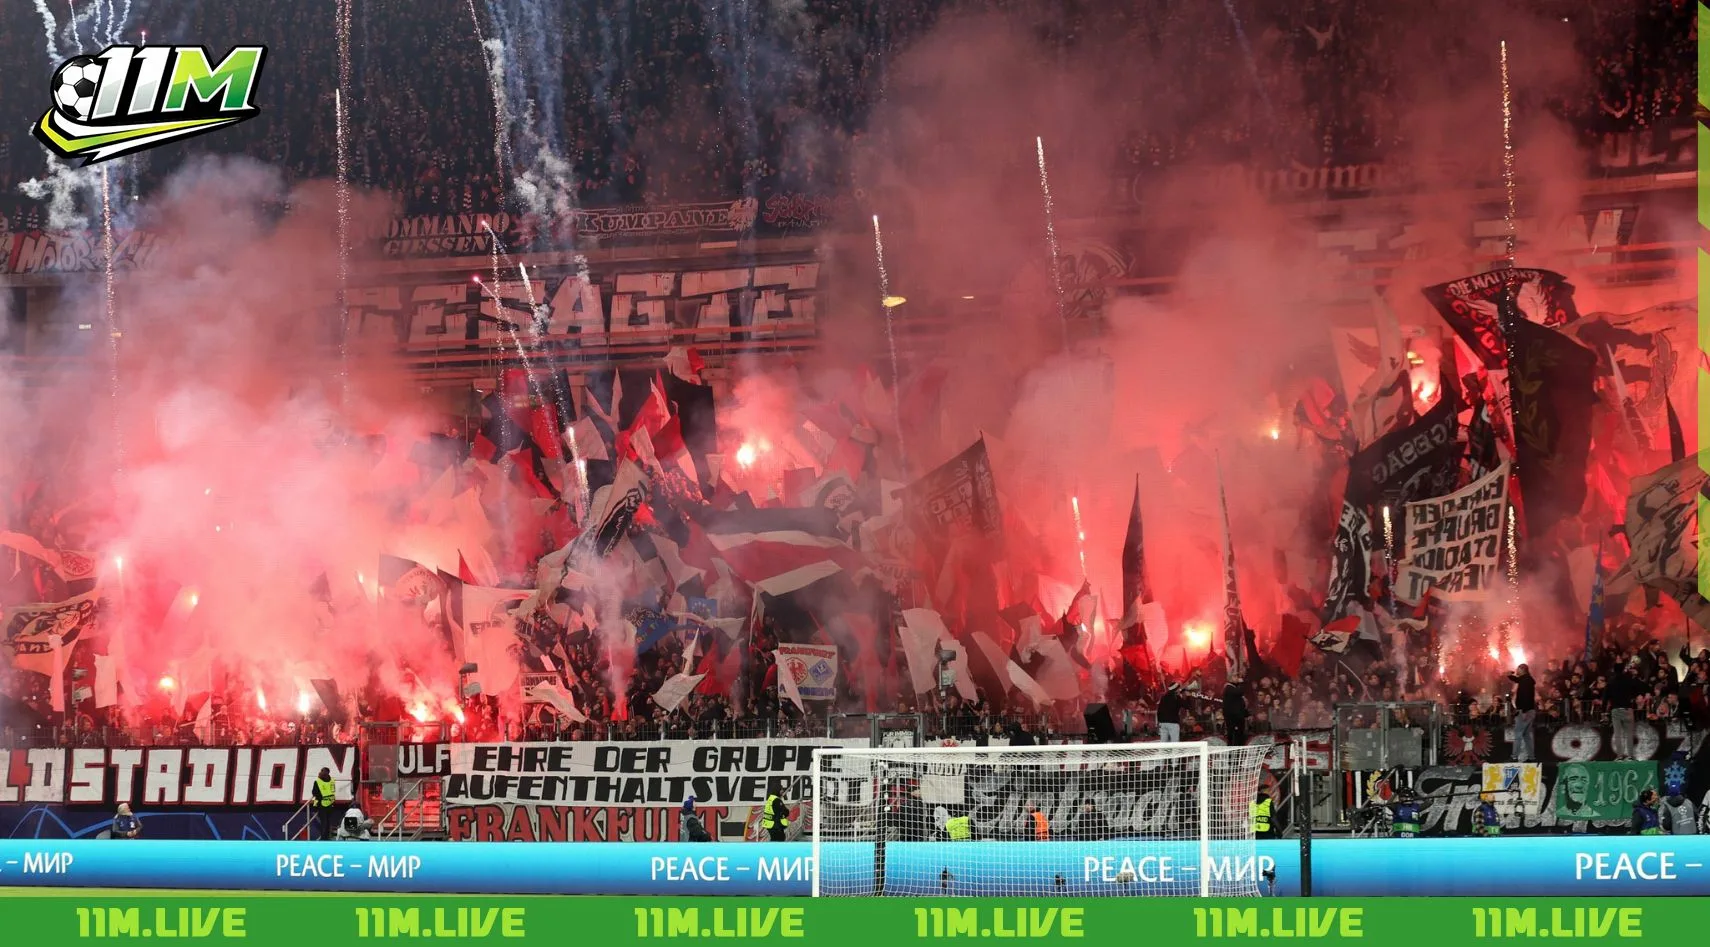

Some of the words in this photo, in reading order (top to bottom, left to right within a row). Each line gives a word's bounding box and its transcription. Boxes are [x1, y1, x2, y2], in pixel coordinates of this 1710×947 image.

[378, 211, 511, 239] OMMANDO
[576, 207, 730, 233] KUMPANE
[472, 746, 573, 772] EHRE
[593, 746, 671, 773] DER
[23, 852, 73, 874] МИР
[276, 854, 344, 877] PEACE
[368, 855, 421, 878] МИР
[651, 857, 729, 881] PEACE
[757, 857, 813, 881] МИР
[1084, 856, 1173, 882] PEACE
[1208, 855, 1275, 881] МИР
[1575, 852, 1677, 880] PEACE
